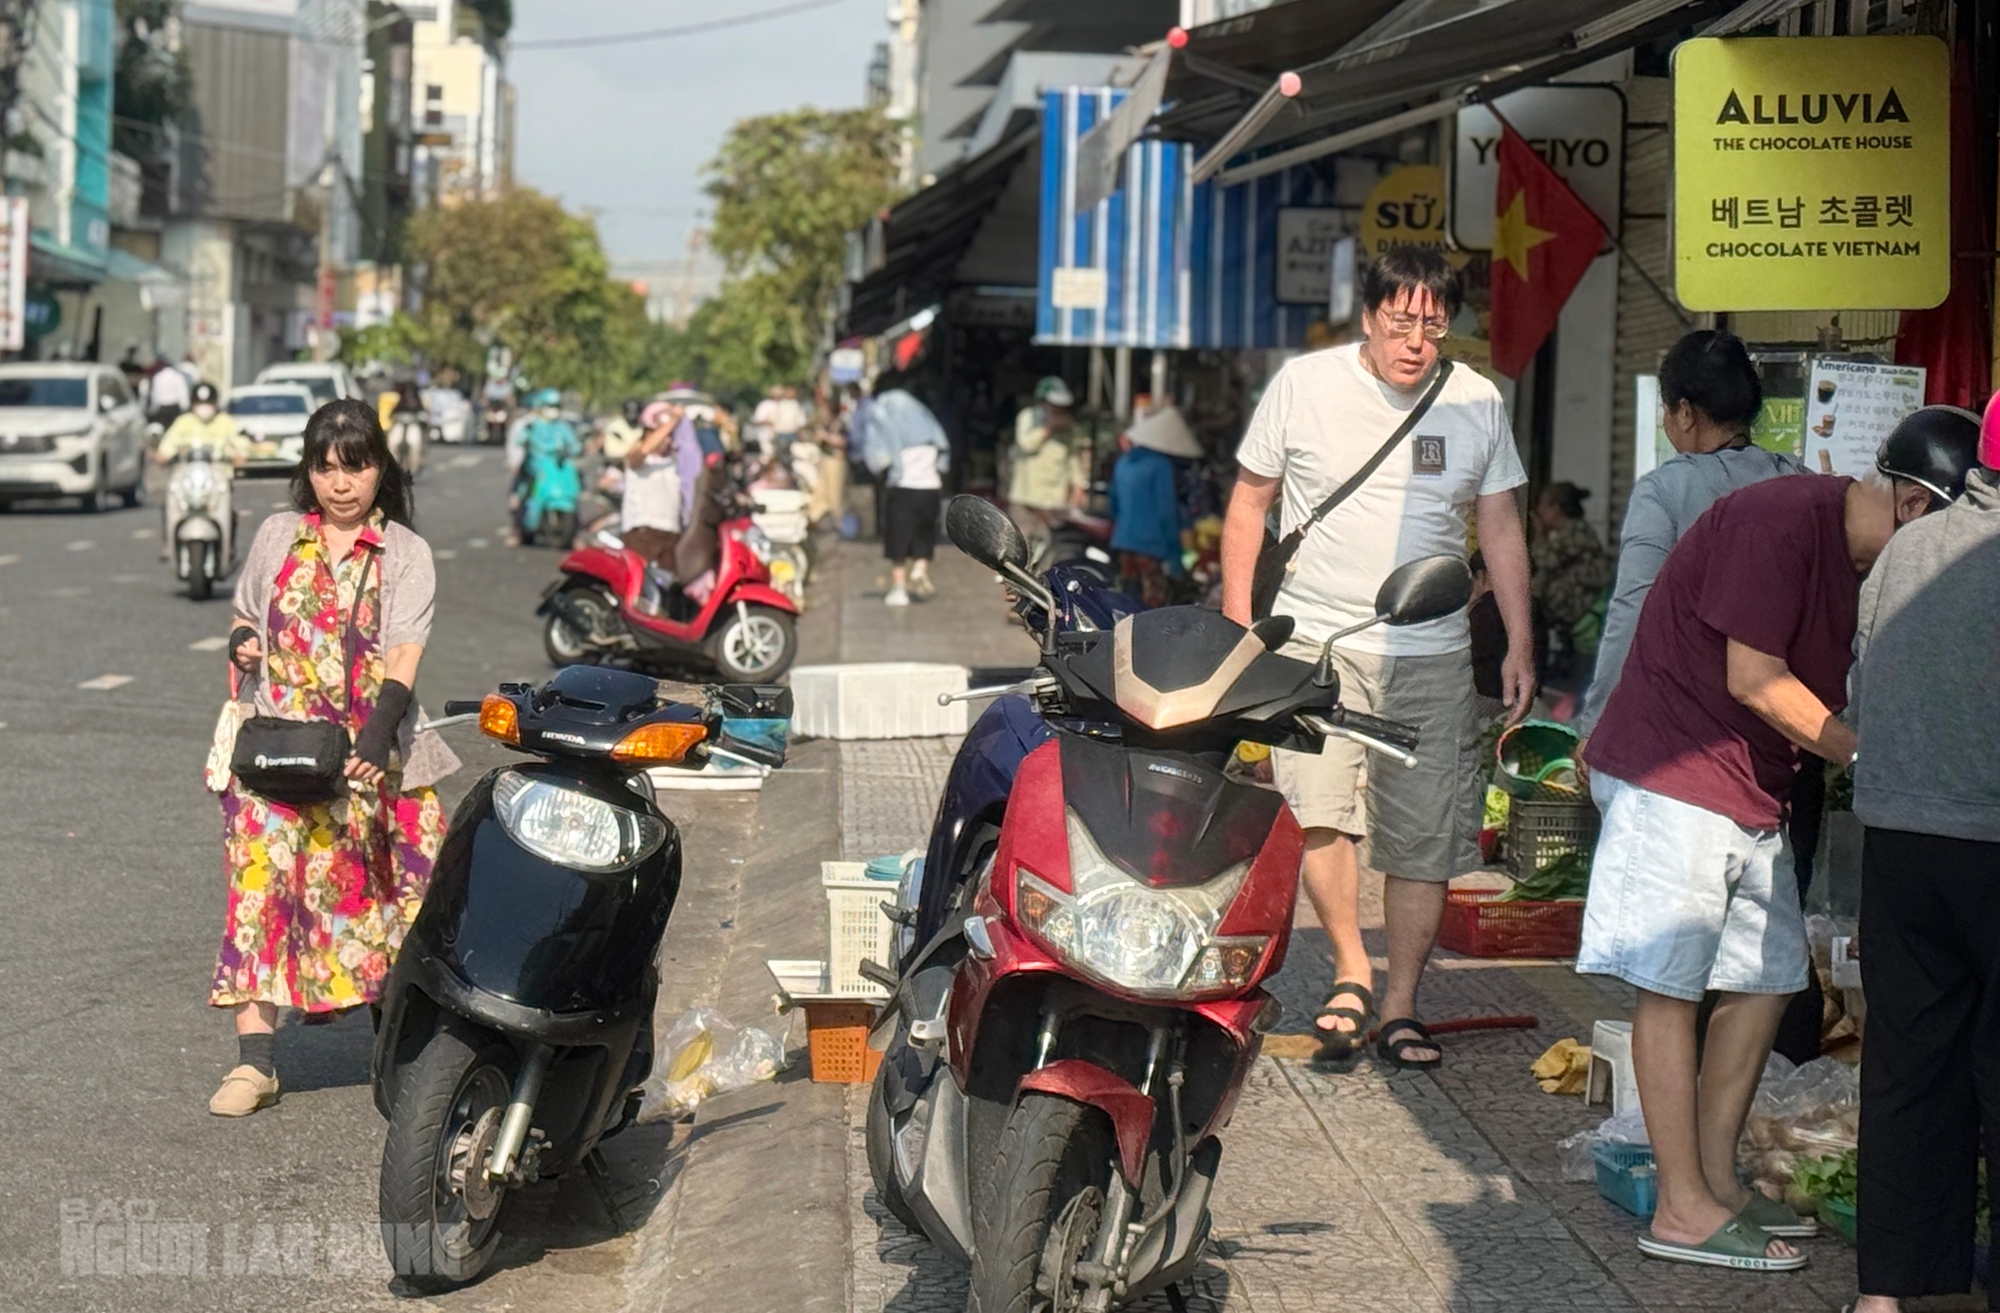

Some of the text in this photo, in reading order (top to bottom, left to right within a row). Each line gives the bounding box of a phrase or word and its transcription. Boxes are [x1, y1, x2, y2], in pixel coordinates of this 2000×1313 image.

[1716, 87, 1909, 125] ALLUVIA
[1471, 137, 1609, 166] YIYO
[1713, 135, 1913, 151] THE CHOCOLATE HOUSE
[1376, 193, 1446, 230] SỮ
[1711, 195, 1913, 229] 베트남 초콜렛
[1706, 241, 1920, 257] CHOCOLATE VIETNAM
[1816, 361, 1877, 374] Americano
[1729, 1257, 1768, 1269] crocs
